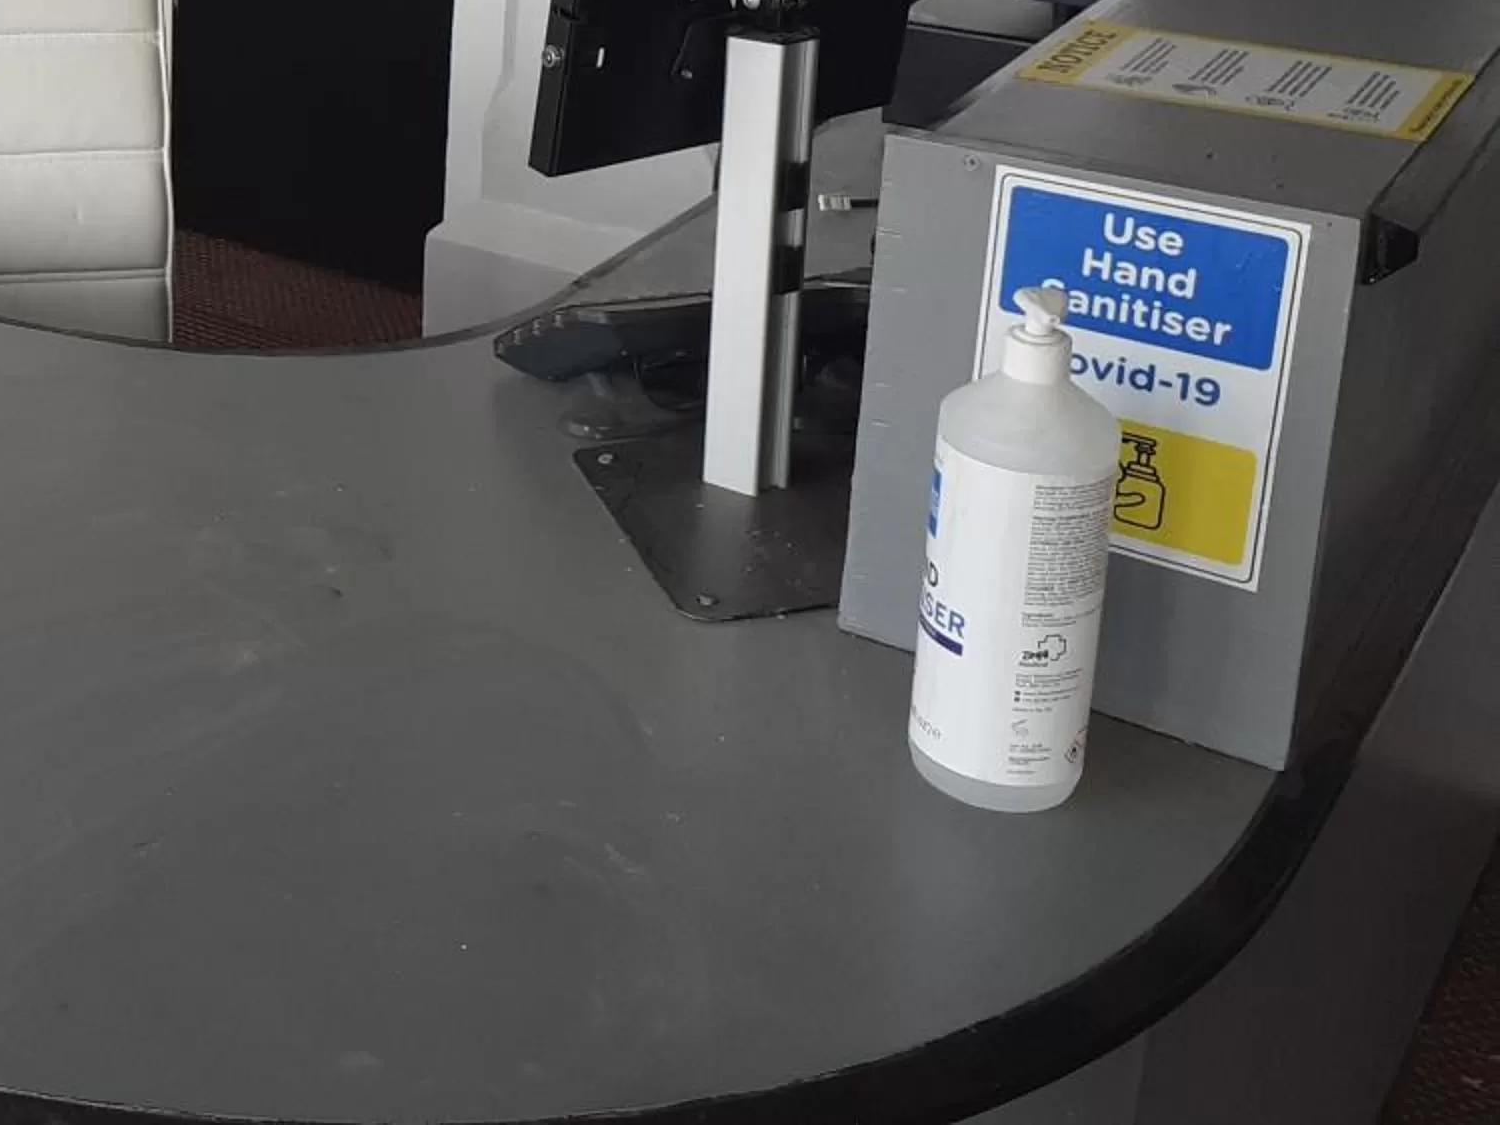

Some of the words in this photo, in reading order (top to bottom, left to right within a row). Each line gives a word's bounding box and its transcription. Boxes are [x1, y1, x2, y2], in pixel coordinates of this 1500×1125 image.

[1103, 213, 1184, 256] Use
[1081, 247, 1197, 299] Hand
[1041, 278, 1232, 346] anitiser
[1069, 353, 1221, 406] ovid-19
